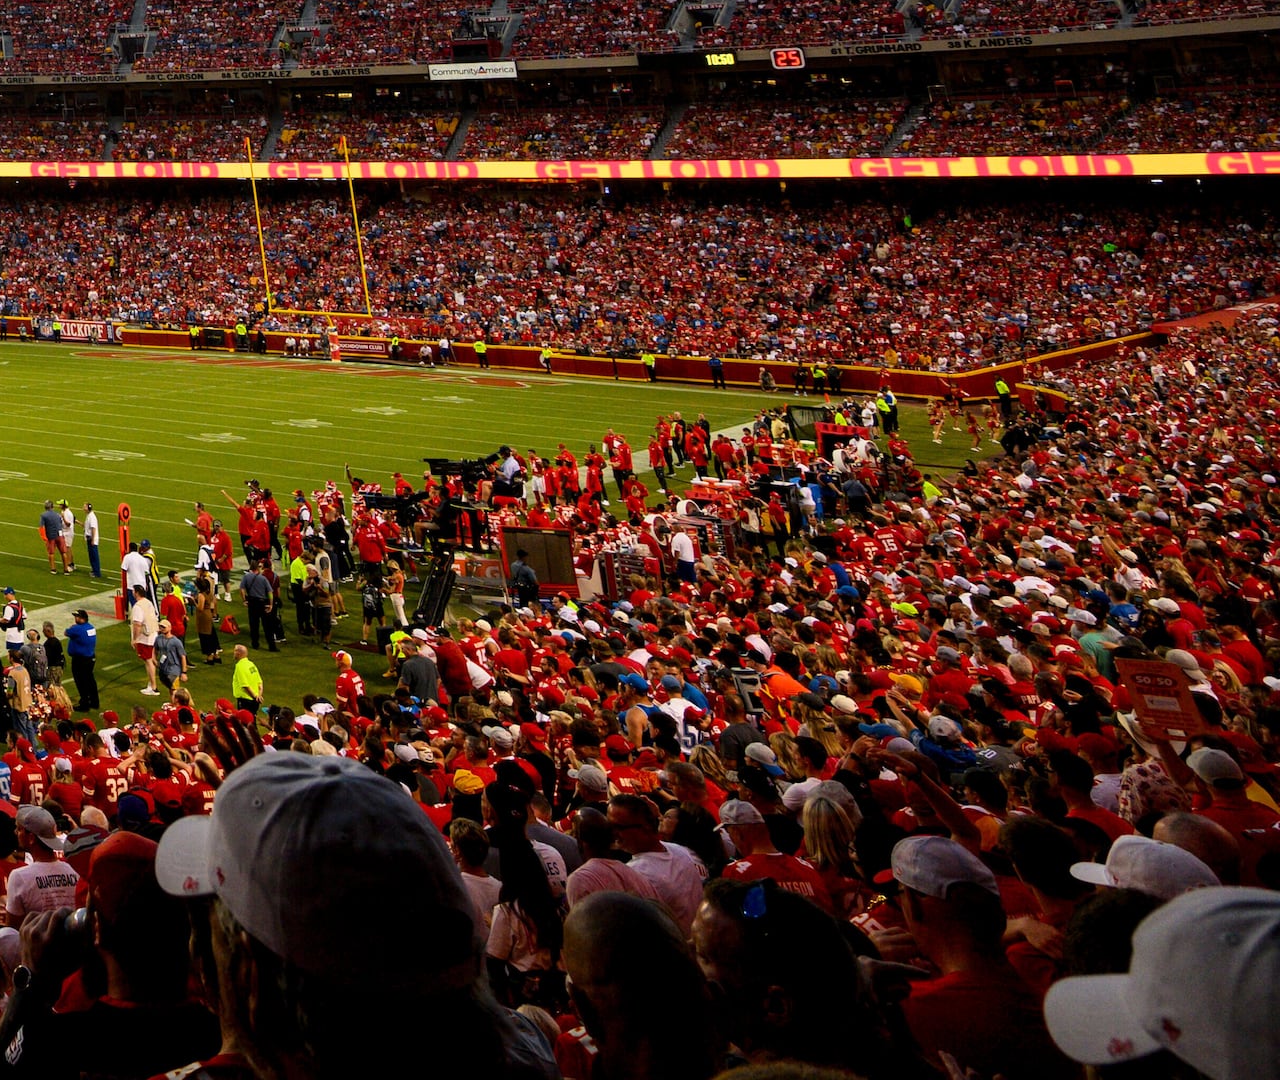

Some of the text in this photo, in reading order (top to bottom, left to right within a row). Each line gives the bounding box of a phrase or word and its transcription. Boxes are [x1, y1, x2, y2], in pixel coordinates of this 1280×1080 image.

[855, 42, 922, 55] GRUNHARD
[948, 40, 962, 50] 38
[979, 36, 1033, 48] ANDERS
[705, 53, 735, 67] 10:50
[775, 50, 801, 67] 25
[71, 74, 127, 83] RICHARDSON
[167, 72, 204, 81] CARSON
[241, 70, 292, 80] GONZALEZ
[331, 67, 371, 77] WATERS
[6, 76, 35, 84] GREEN
[30, 162, 219, 177] GET LOUD
[269, 162, 478, 177] GET LOUD
[536, 160, 780, 177] GET LOUD
[851, 156, 1133, 177] GET LOUD
[883, 539, 898, 552] 15
[29, 783, 44, 805] 15
[106, 777, 129, 803] 32
[776, 880, 815, 898] ATSON
